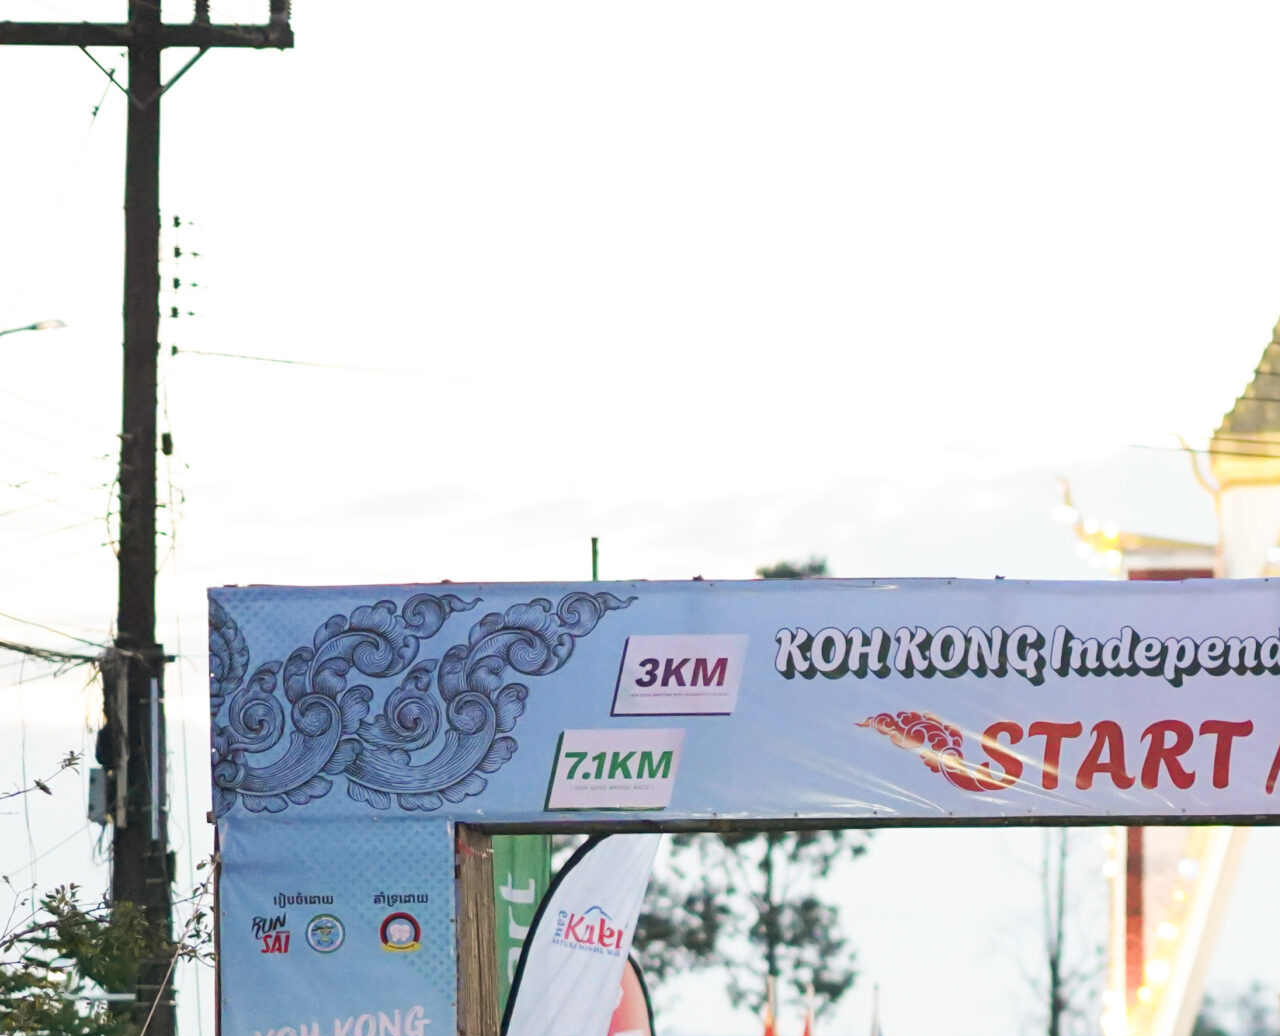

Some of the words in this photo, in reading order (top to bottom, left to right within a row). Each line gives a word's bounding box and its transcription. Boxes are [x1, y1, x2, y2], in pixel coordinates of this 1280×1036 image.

[775, 625, 891, 680] KOH
[894, 624, 1046, 687] KONG
[635, 657, 729, 688] 3KM
[564, 750, 674, 780] 7.1KM
[950, 717, 1254, 792] START
[251, 912, 287, 940] RUN
[260, 933, 291, 954] SAI
